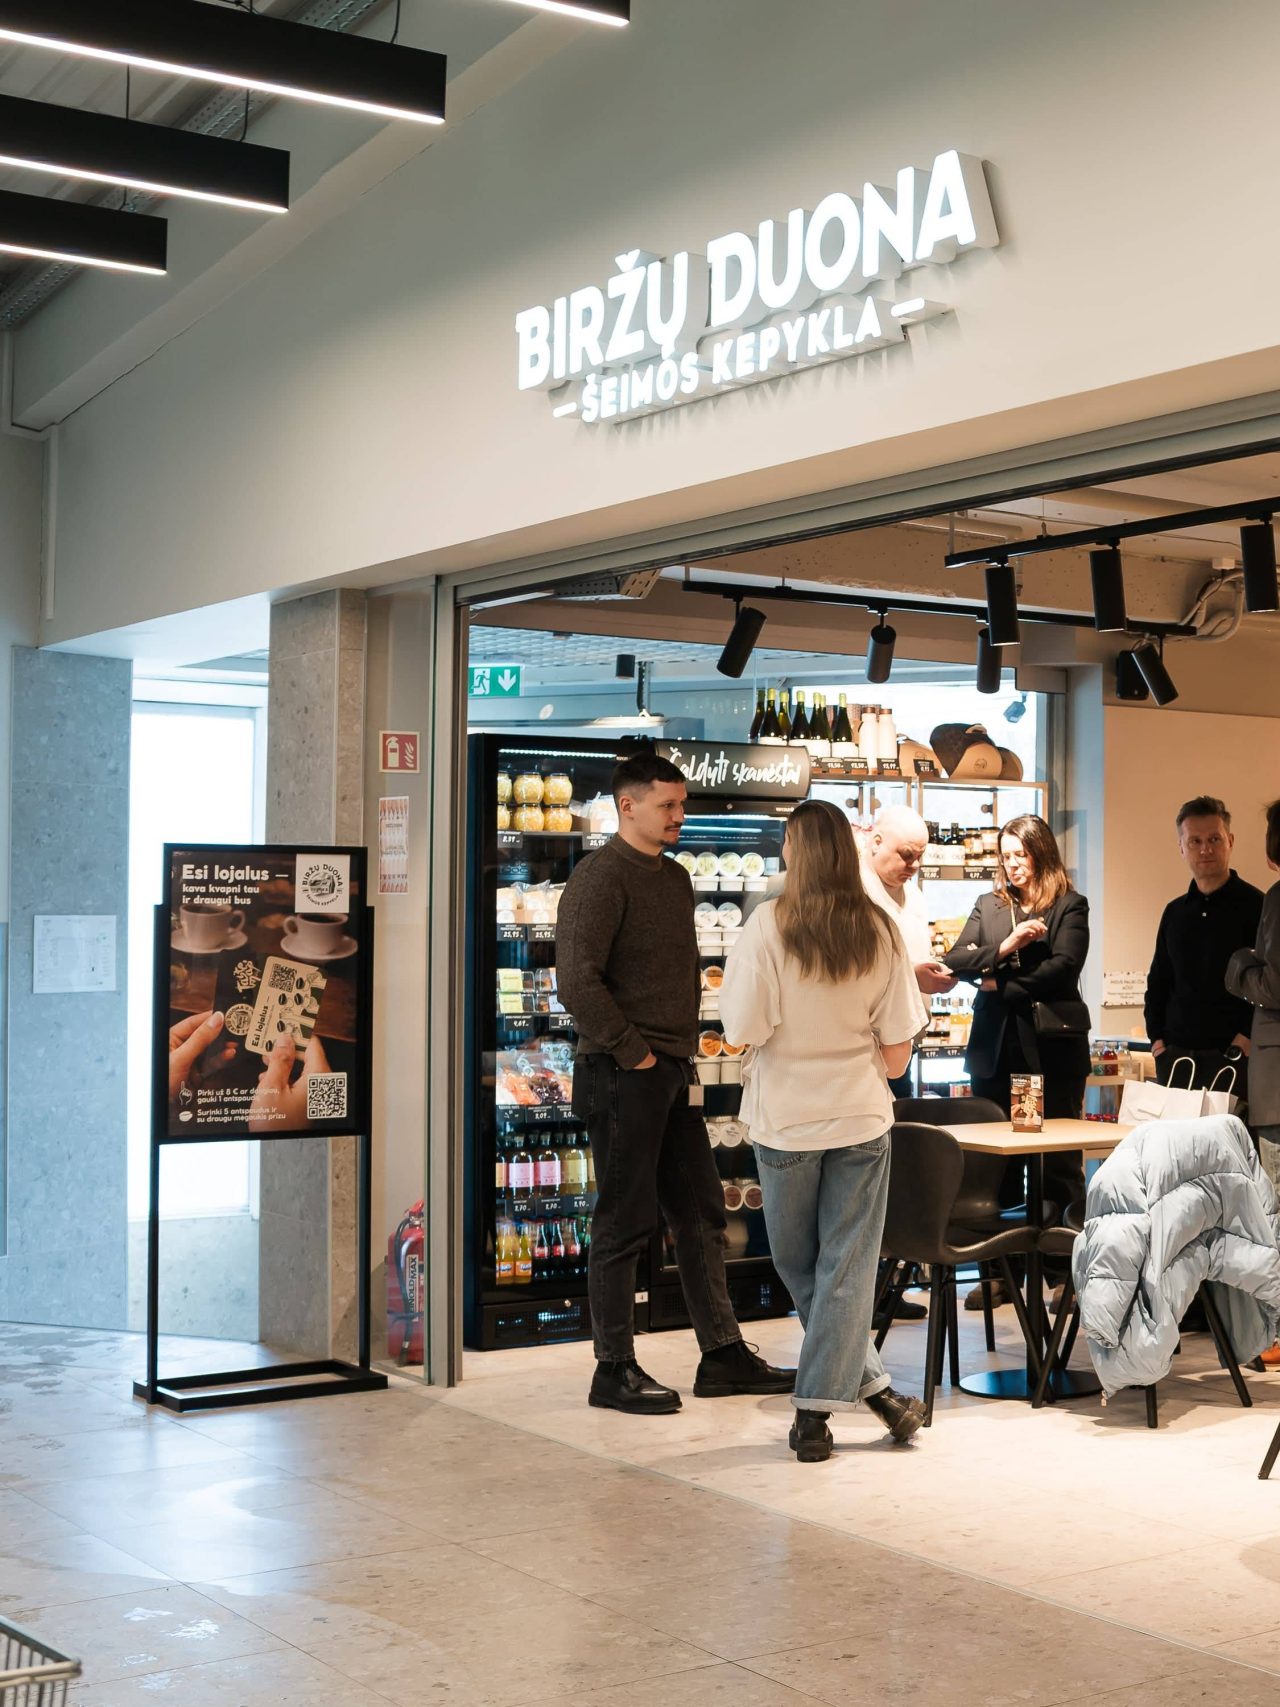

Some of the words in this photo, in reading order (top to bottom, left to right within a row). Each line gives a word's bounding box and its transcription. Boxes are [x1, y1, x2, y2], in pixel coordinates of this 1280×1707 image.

[515, 248, 690, 390] BIRŽŲ
[707, 149, 978, 329] DUONA
[581, 353, 699, 423] ŠEIMOS
[712, 295, 882, 385] KEPYKLA
[182, 864, 208, 880] Esi
[214, 864, 270, 884] lojalus
[182, 883, 206, 893] kava
[208, 884, 241, 895] kvapni
[243, 885, 260, 894] tau
[182, 895, 191, 904] ir
[193, 895, 231, 906] draugui
[233, 895, 251, 904] bus
[256, 1005, 268, 1033] lojalus
[252, 1035, 261, 1047] Esi
[197, 1108, 222, 1116] Surinki
